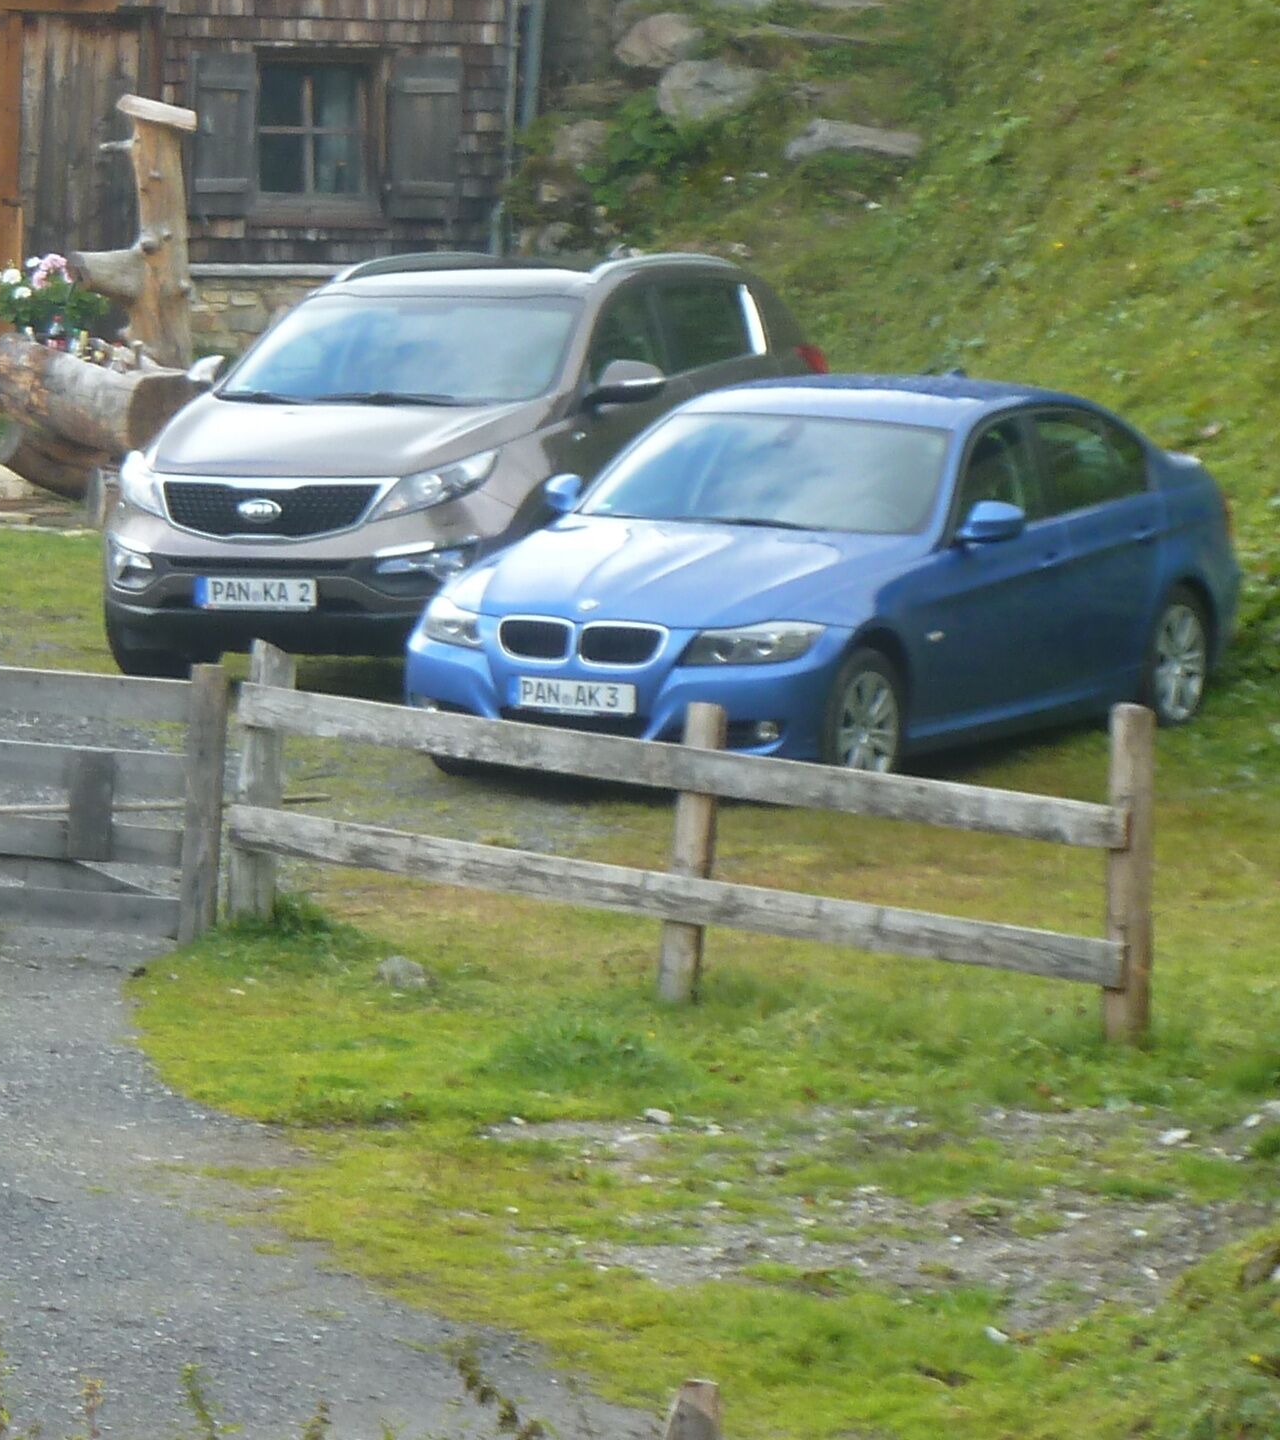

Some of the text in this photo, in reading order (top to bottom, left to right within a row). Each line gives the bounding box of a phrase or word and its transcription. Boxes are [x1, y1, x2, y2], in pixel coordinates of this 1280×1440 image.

[211, 581, 311, 603] PAN KA 2
[522, 679, 619, 707] PAN AK 3
